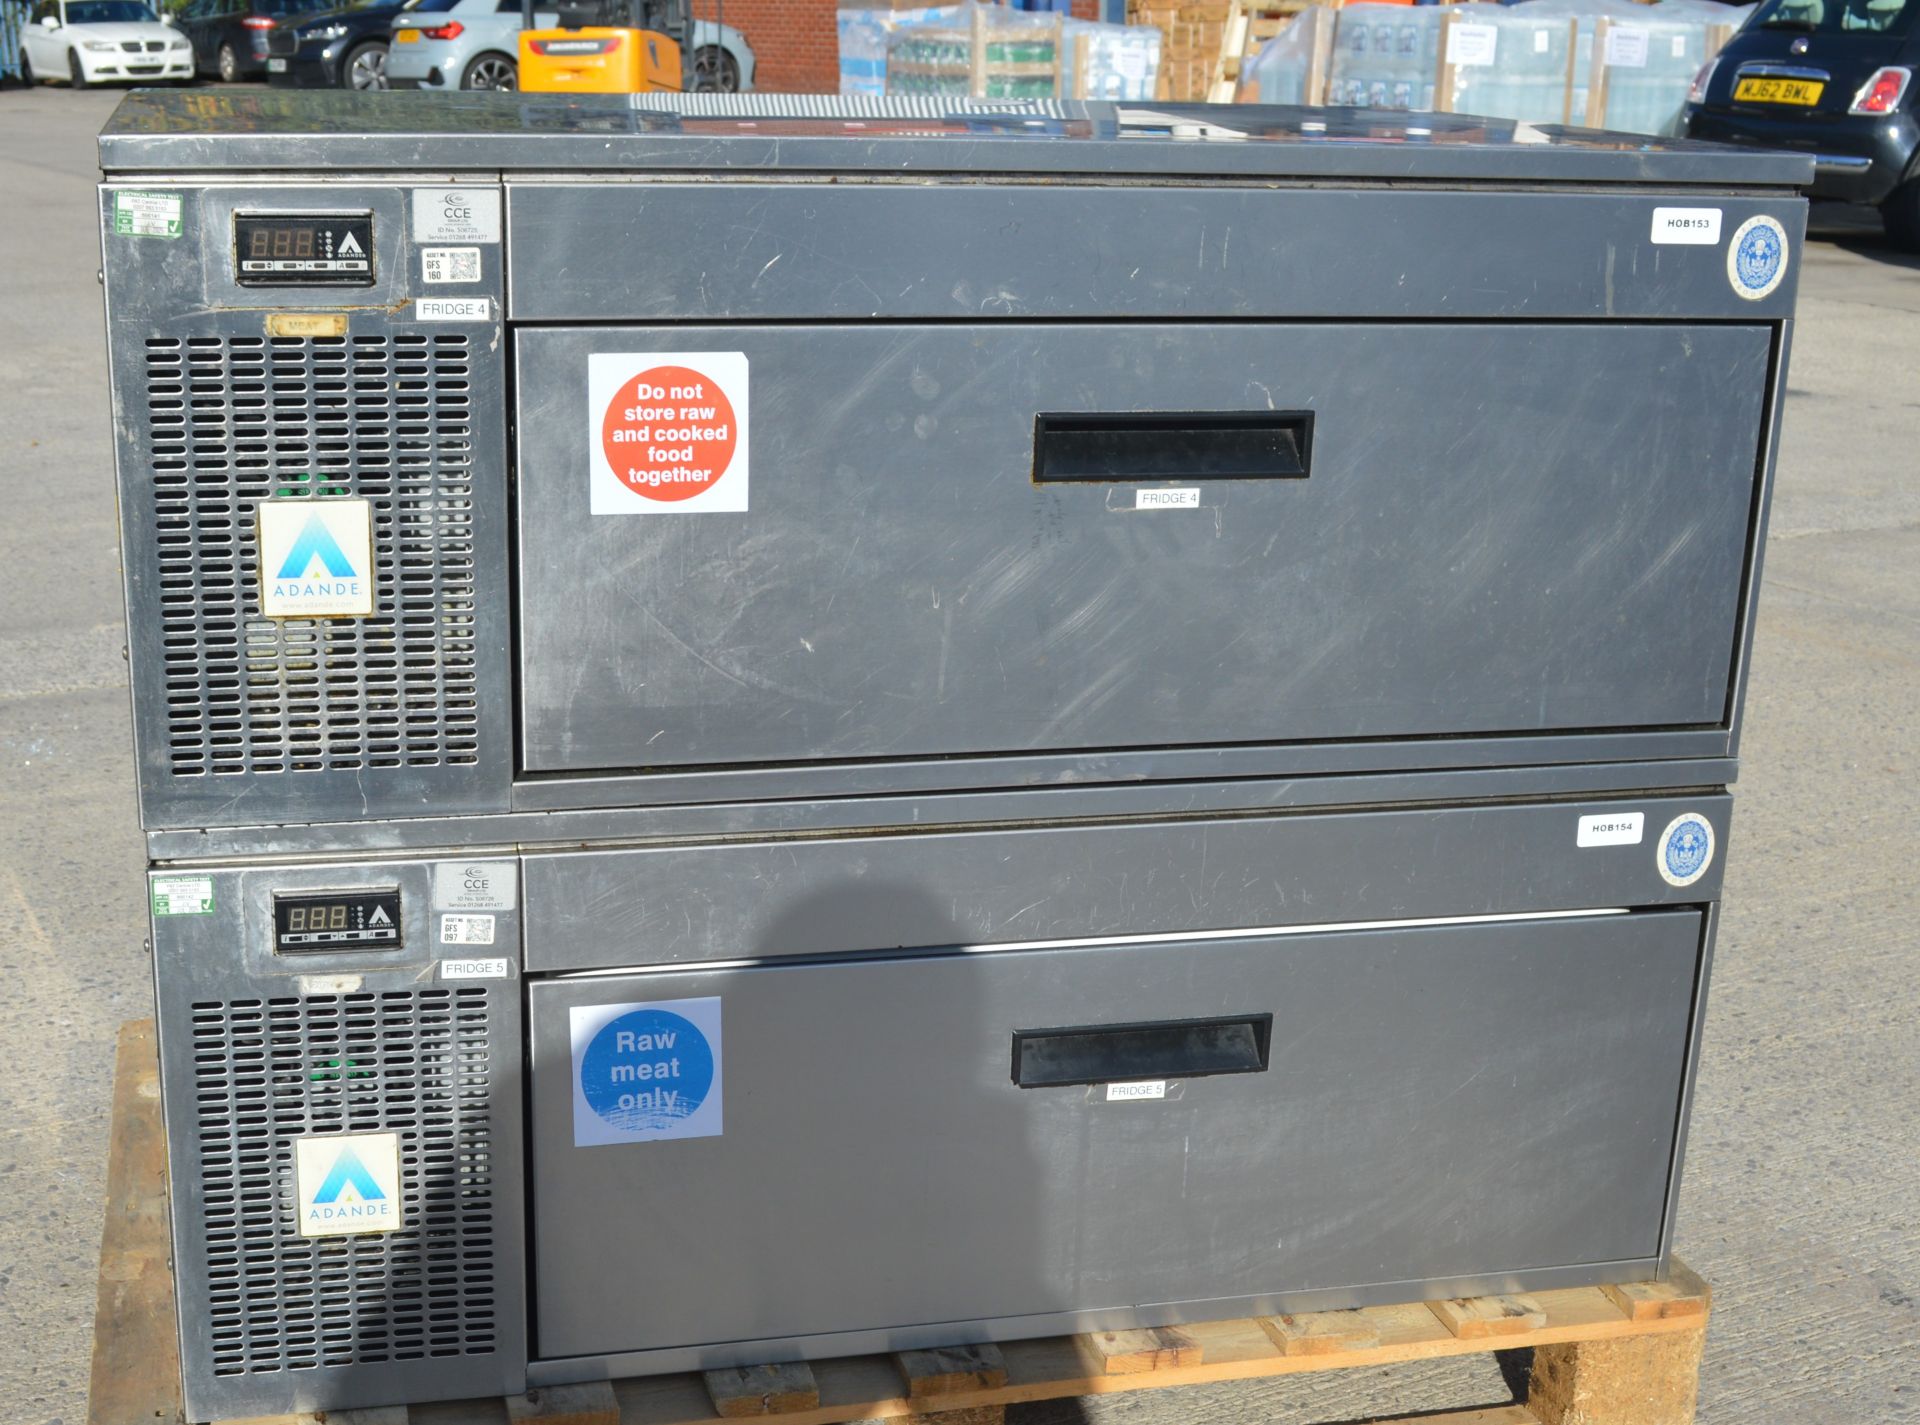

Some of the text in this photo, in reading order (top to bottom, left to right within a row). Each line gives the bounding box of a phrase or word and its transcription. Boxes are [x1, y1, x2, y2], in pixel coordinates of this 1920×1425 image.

[444, 208, 472, 218] CCE
[1667, 219, 1710, 228] HOB153
[426, 260, 440, 270] GFS
[428, 271, 442, 280] 160
[423, 304, 485, 315] FRIDGE 4
[637, 383, 703, 400] Do not
[624, 405, 716, 421] store raw
[612, 424, 728, 442] and cooked
[648, 445, 693, 462] food
[628, 466, 712, 486] together
[1142, 492, 1197, 504] FRIDGE 4
[274, 583, 358, 596] ADANDE
[1592, 823, 1633, 832] HOB154
[464, 880, 489, 889] CCE
[445, 924, 458, 932] GFS
[444, 934, 458, 942] 097
[446, 962, 504, 974] FRIDGE 5
[616, 1031, 677, 1054] Raw
[610, 1057, 680, 1082] meat
[1111, 1085, 1162, 1096] FRIDGE 5
[618, 1086, 679, 1115] only
[309, 1204, 388, 1220] ADANDE
